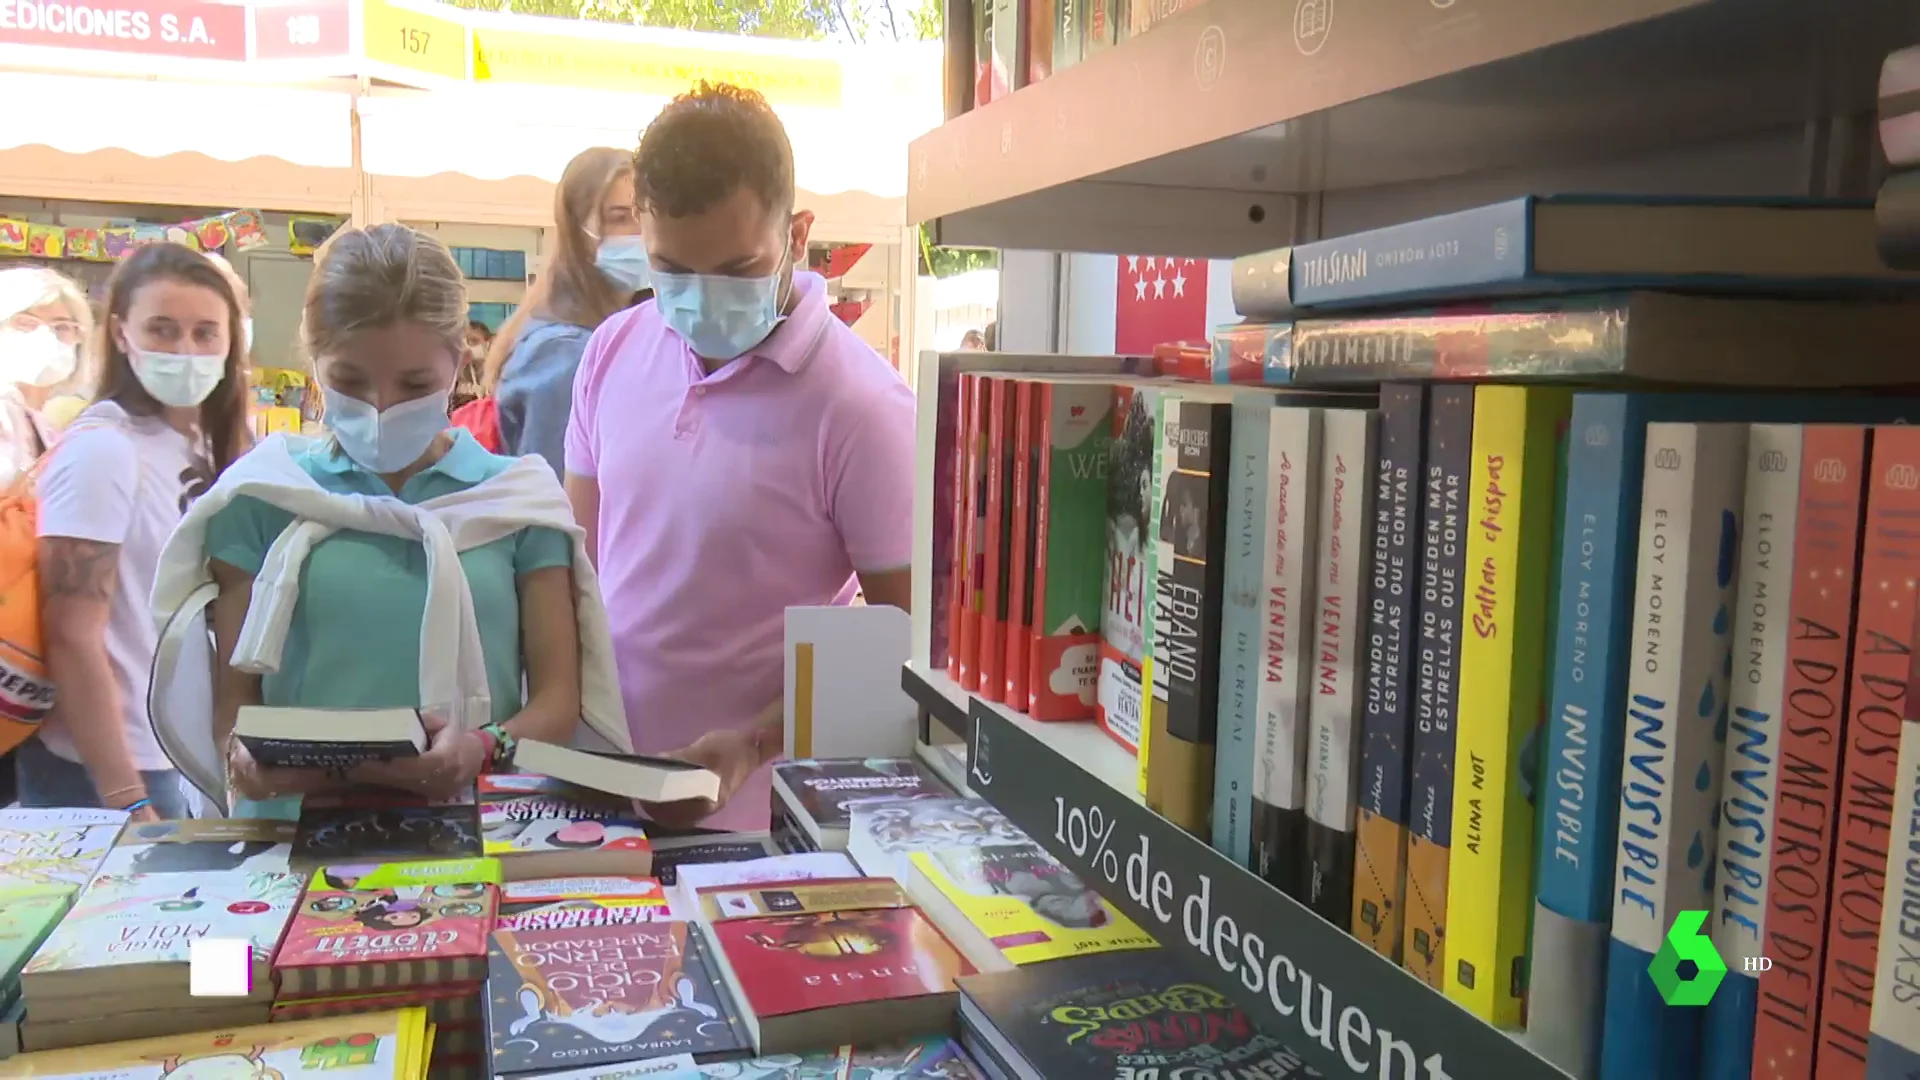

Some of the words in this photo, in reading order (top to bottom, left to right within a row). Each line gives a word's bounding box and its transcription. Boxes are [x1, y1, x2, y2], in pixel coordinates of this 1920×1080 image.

[0, 1, 152, 41] EDICIONES
[160, 15, 217, 46] S.A.
[400, 27, 431, 55] 157
[1303, 248, 1367, 287] INVISIBLE
[1375, 248, 1425, 268] MORENO
[1428, 240, 1460, 261] ELOY
[1392, 467, 1408, 546] CONTAR
[1443, 474, 1459, 557] CONTAR
[1482, 454, 1506, 543] chispas
[1375, 510, 1390, 589] QUEDEN
[1425, 520, 1440, 602] QUEDEN
[1581, 513, 1596, 570] ELOY
[1653, 508, 1667, 564] ELOY
[1757, 512, 1773, 570] ELOY
[1390, 556, 1404, 596] QUE
[1441, 567, 1455, 608] QUE
[1169, 583, 1202, 683] ÉBANO
[1266, 586, 1288, 684] VENTANA
[1373, 599, 1385, 624] NO
[1424, 610, 1436, 639] NO
[1572, 581, 1591, 684] MORENO
[1645, 574, 1663, 674] MORENO
[1748, 581, 1768, 684] MORENO
[1796, 616, 1840, 641] A
[1319, 596, 1341, 695] VENTANA
[1385, 604, 1402, 714] ESTRELLAS
[1865, 629, 1911, 656] A
[1368, 633, 1383, 714] CUANDO
[1420, 650, 1434, 733] CUANDO
[1436, 619, 1453, 732] ESTRELLAS
[1788, 658, 1838, 745] DOS
[1854, 674, 1908, 767] DOS
[1470, 750, 1486, 792] NOT
[1556, 703, 1588, 870] INVISIBLE
[1466, 798, 1482, 855] ALINA
[1621, 694, 1667, 920] INVISIBLE
[1721, 706, 1771, 941] INVISIBLE
[1055, 796, 1118, 883] 10%
[1127, 835, 1173, 923] de
[1772, 752, 1829, 924] METROS
[1839, 770, 1896, 949] METROS
[499, 904, 662, 931] MENTIROSOS
[515, 932, 677, 952] EMPERADOR
[516, 945, 681, 968] ETERNO
[548, 970, 662, 991] CICLO
[586, 961, 628, 972] DEL
[1770, 931, 1814, 990] DE
[1832, 959, 1874, 1010] DE
[582, 987, 626, 1001] EL
[1051, 982, 1226, 1046] REBELDES
[552, 1045, 633, 1058] GALLEGO
[636, 1039, 692, 1052] LAURA
